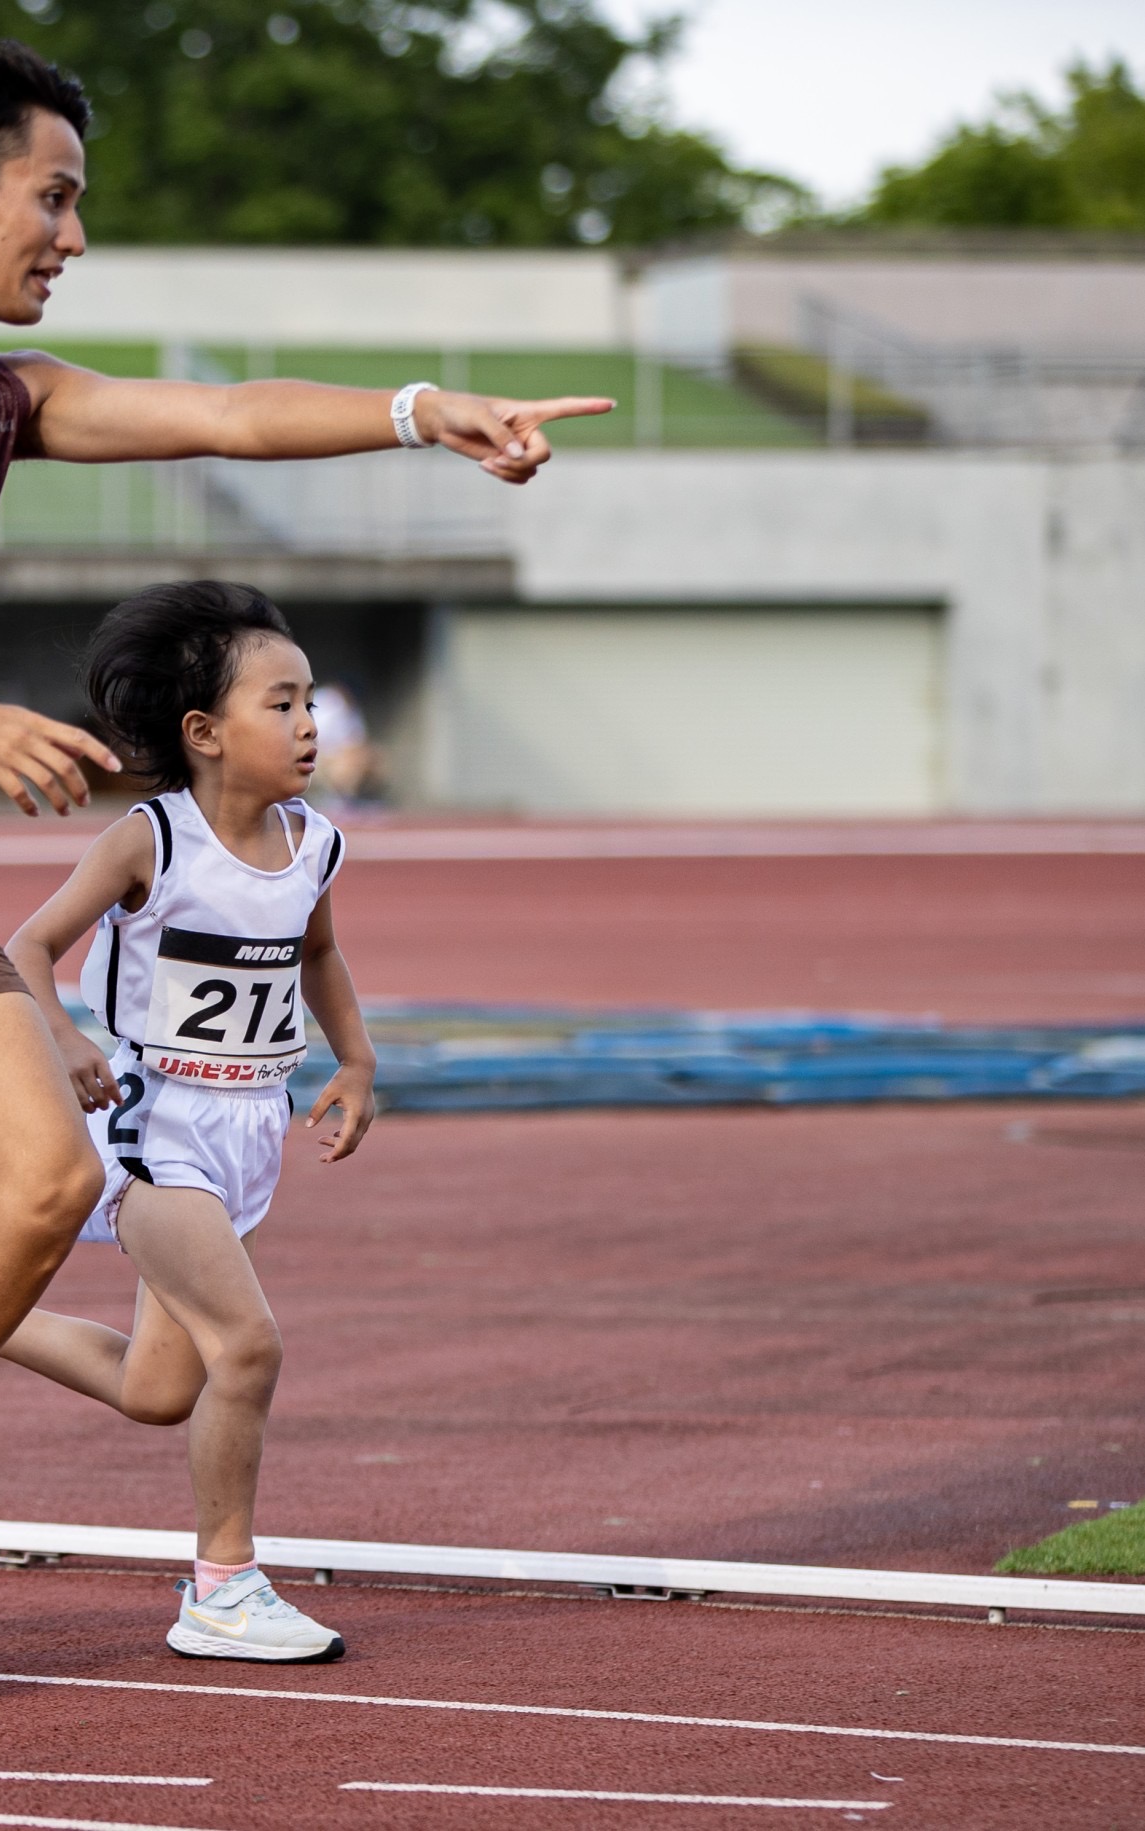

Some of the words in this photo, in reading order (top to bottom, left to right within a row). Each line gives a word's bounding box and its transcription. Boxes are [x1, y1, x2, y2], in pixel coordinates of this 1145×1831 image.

[234, 945, 295, 961] MDC
[175, 979, 297, 1044] 212
[158, 1057, 256, 1081] リポビタン
[257, 1064, 275, 1081] for
[107, 1072, 145, 1145] 2
